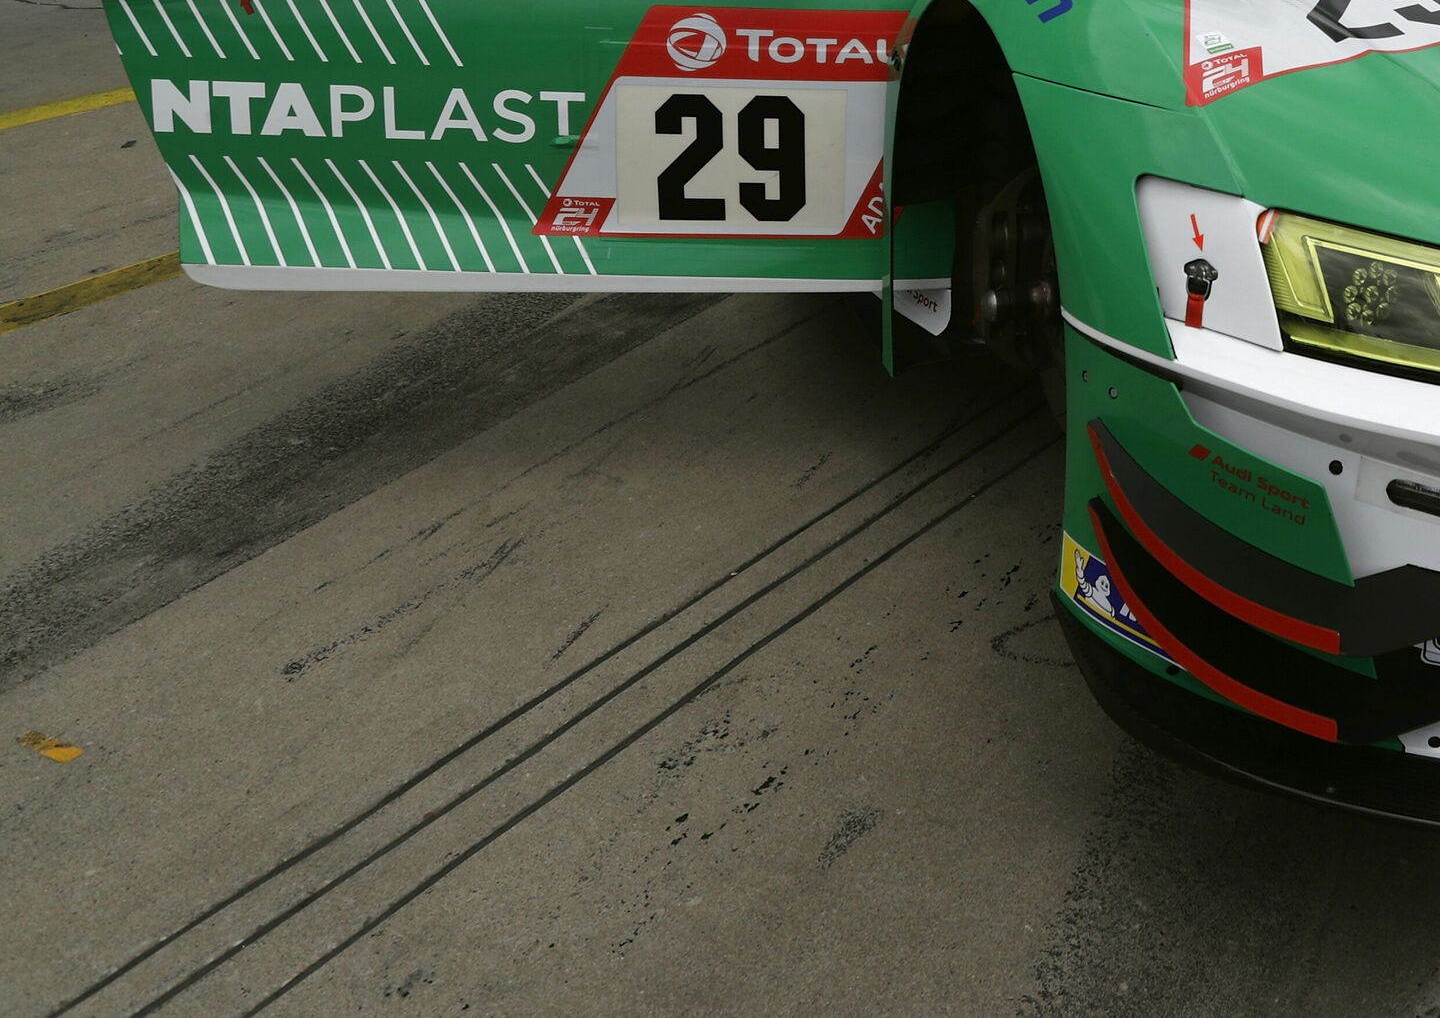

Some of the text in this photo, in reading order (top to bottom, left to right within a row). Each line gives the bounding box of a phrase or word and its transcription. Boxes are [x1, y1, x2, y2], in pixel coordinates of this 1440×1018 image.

[736, 28, 895, 65] TOTAL
[1214, 53, 1248, 65] TOTAL
[1204, 76, 1250, 99] nürburgring
[654, 94, 806, 222] 29
[573, 199, 601, 207] TOTAL
[551, 225, 590, 233] nürburgring
[912, 289, 938, 313] Sport
[1211, 455, 1310, 510] Audi Sport
[1210, 469, 1307, 526] Team Land
